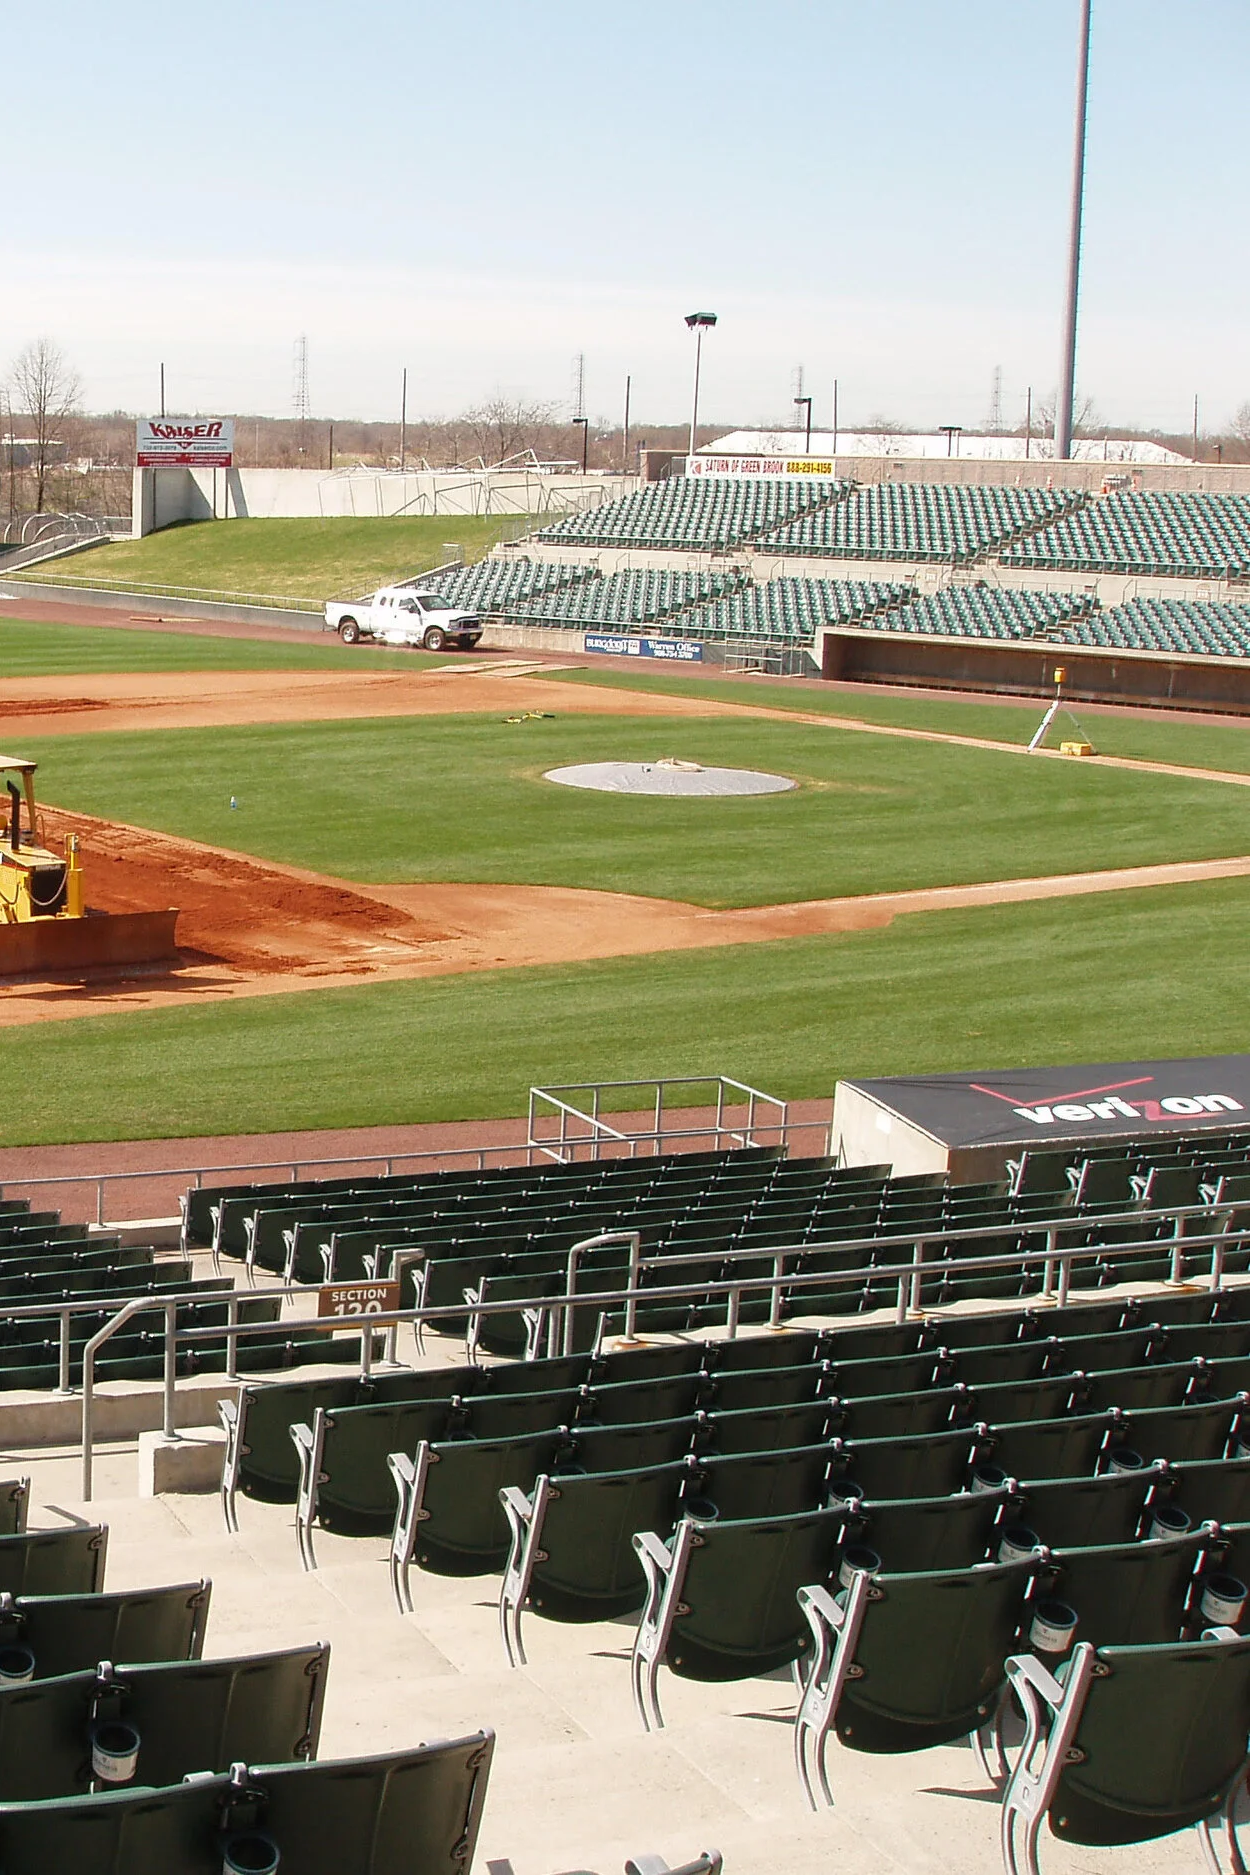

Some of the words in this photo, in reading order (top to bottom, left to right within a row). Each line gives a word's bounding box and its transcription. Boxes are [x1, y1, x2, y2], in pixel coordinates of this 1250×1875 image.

[148, 421, 223, 440] KAISER
[705, 459, 729, 472] SATURN
[731, 459, 739, 472] OF
[740, 460, 761, 473] GREEN
[762, 460, 784, 474] BROOK
[647, 640, 675, 651] Warren
[676, 643, 700, 653] Office
[1012, 1094, 1244, 1125] verizon
[331, 1287, 387, 1302] SECTION
[334, 1300, 382, 1316] 120
